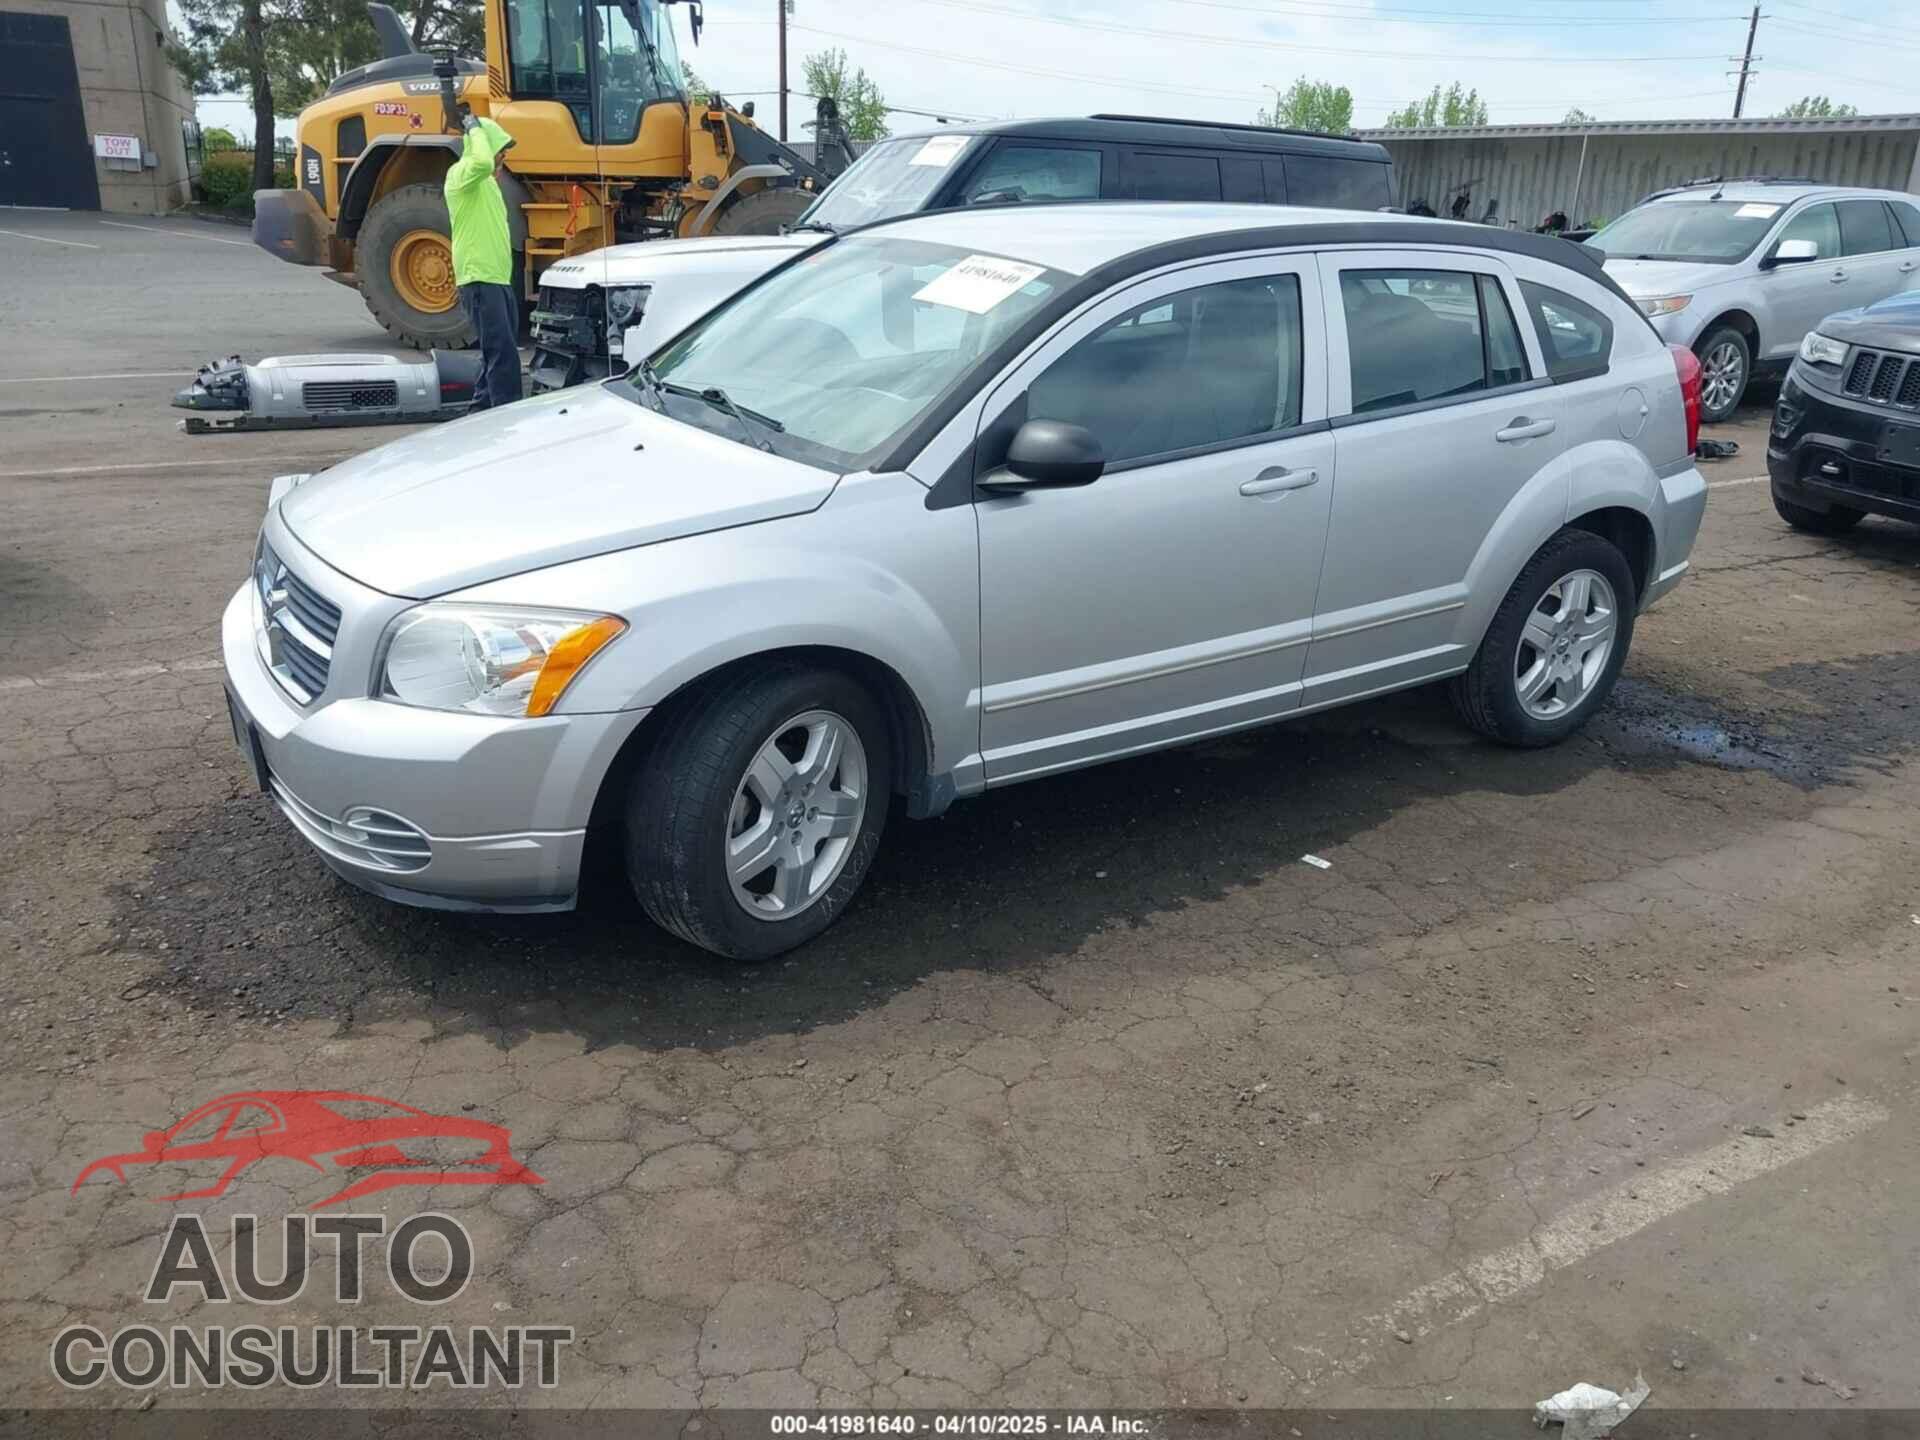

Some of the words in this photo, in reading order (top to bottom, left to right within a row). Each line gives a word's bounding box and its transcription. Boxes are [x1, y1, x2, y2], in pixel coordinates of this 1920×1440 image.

[408, 82, 460, 91] VOLO
[104, 138, 129, 146] TOW
[105, 147, 129, 155] OUT
[307, 159, 320, 184] L90H
